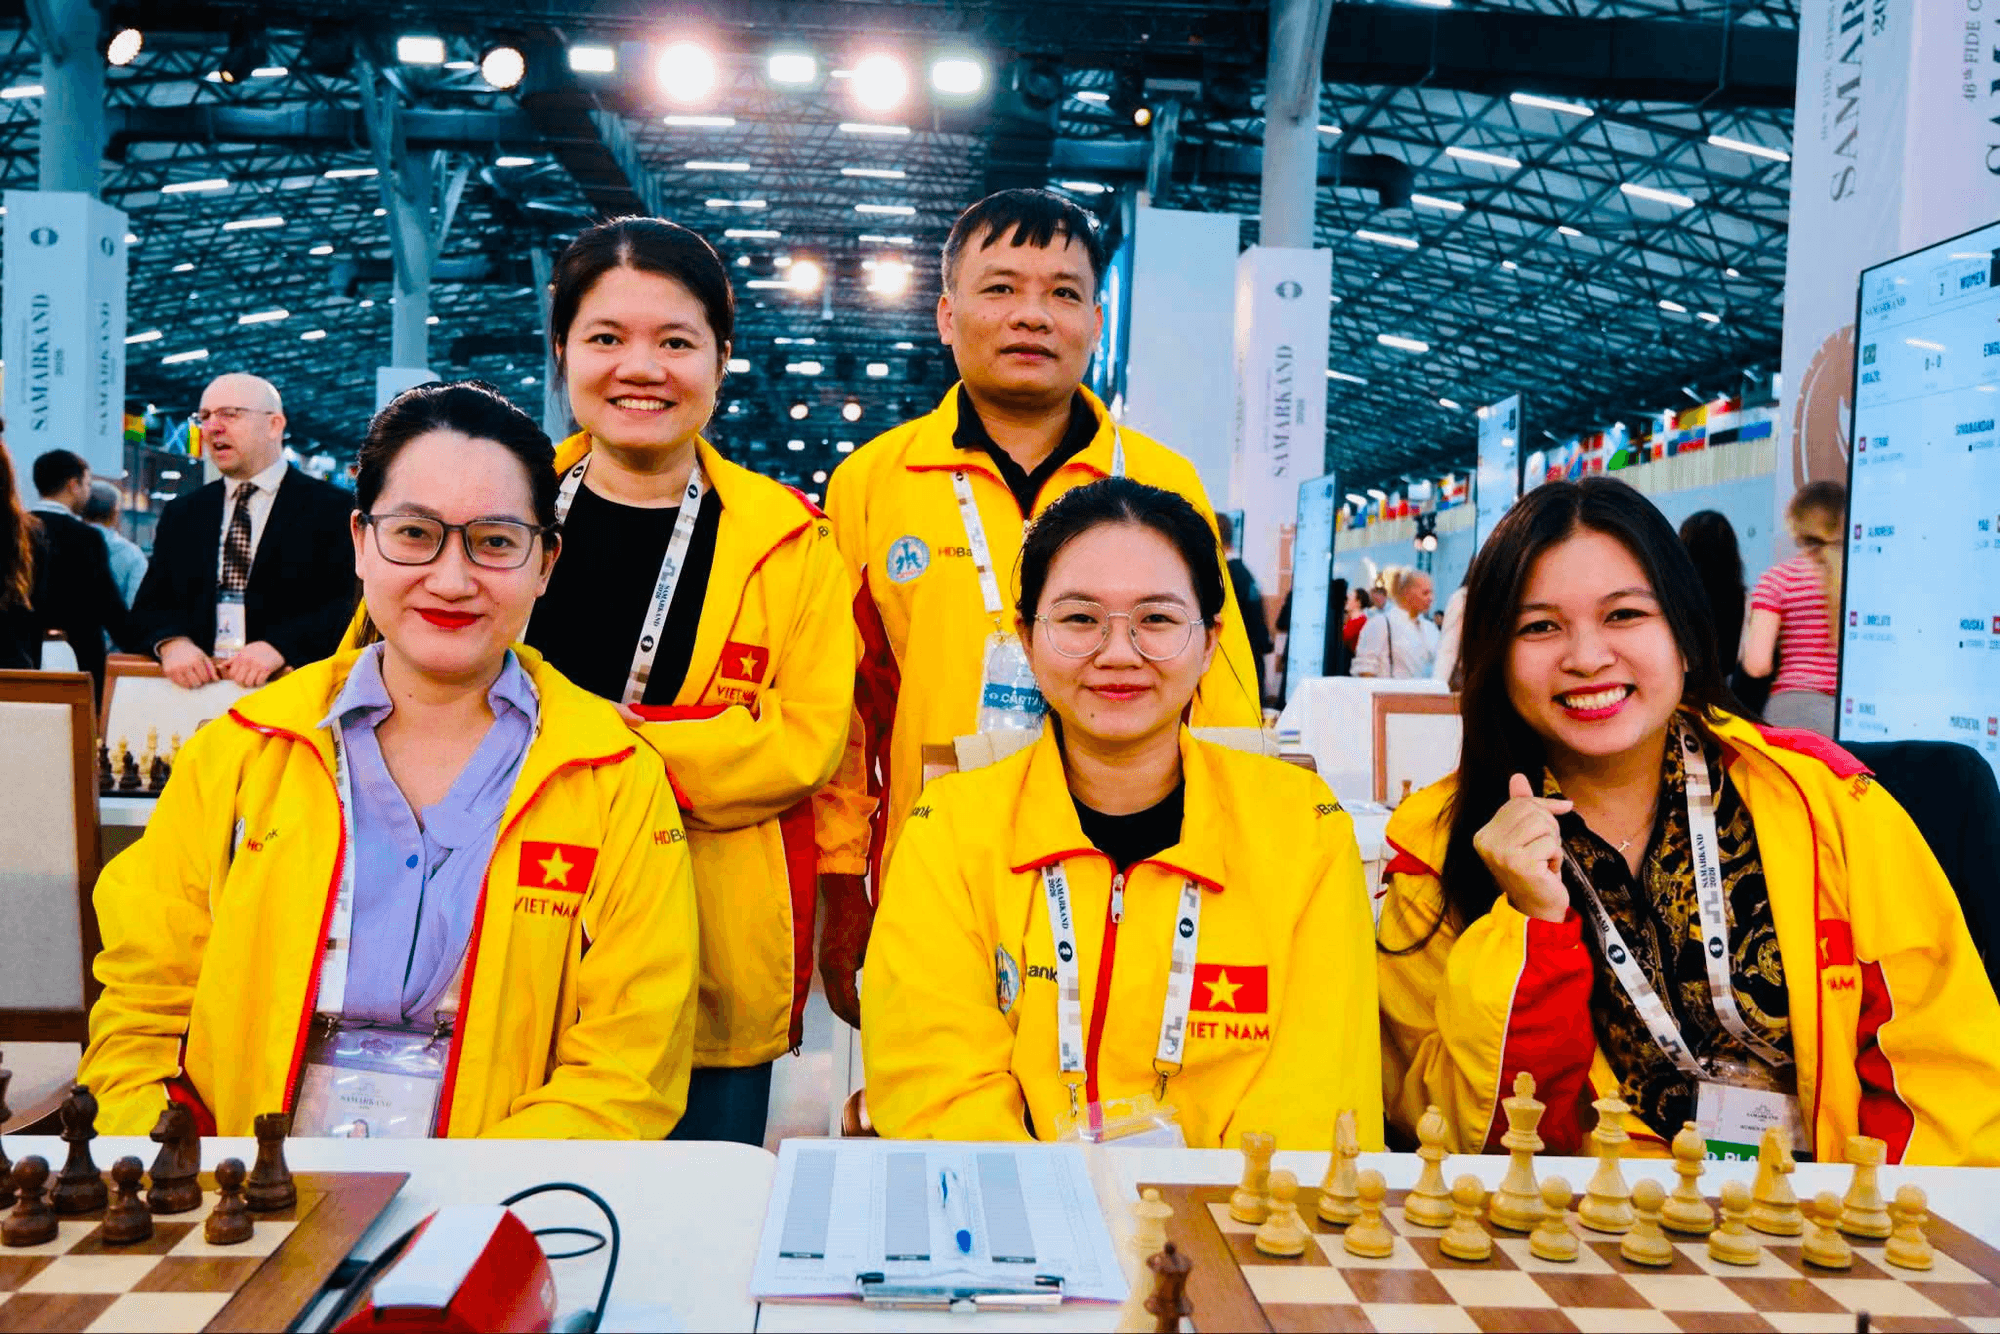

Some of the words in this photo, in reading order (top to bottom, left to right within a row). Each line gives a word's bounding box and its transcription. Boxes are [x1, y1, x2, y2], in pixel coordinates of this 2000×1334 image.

[1963, 20, 1980, 64] FIDE
[30, 294, 50, 431] SAMARKAND
[1272, 345, 1294, 479] SAMARKAND
[1695, 833, 1709, 889] SAMARKAND
[1708, 866, 1717, 888] 2026
[514, 897, 550, 915] VIET
[1056, 877, 1070, 930] SAMARKAND
[1186, 1021, 1219, 1039] IET
[1225, 1022, 1270, 1040] NAM
